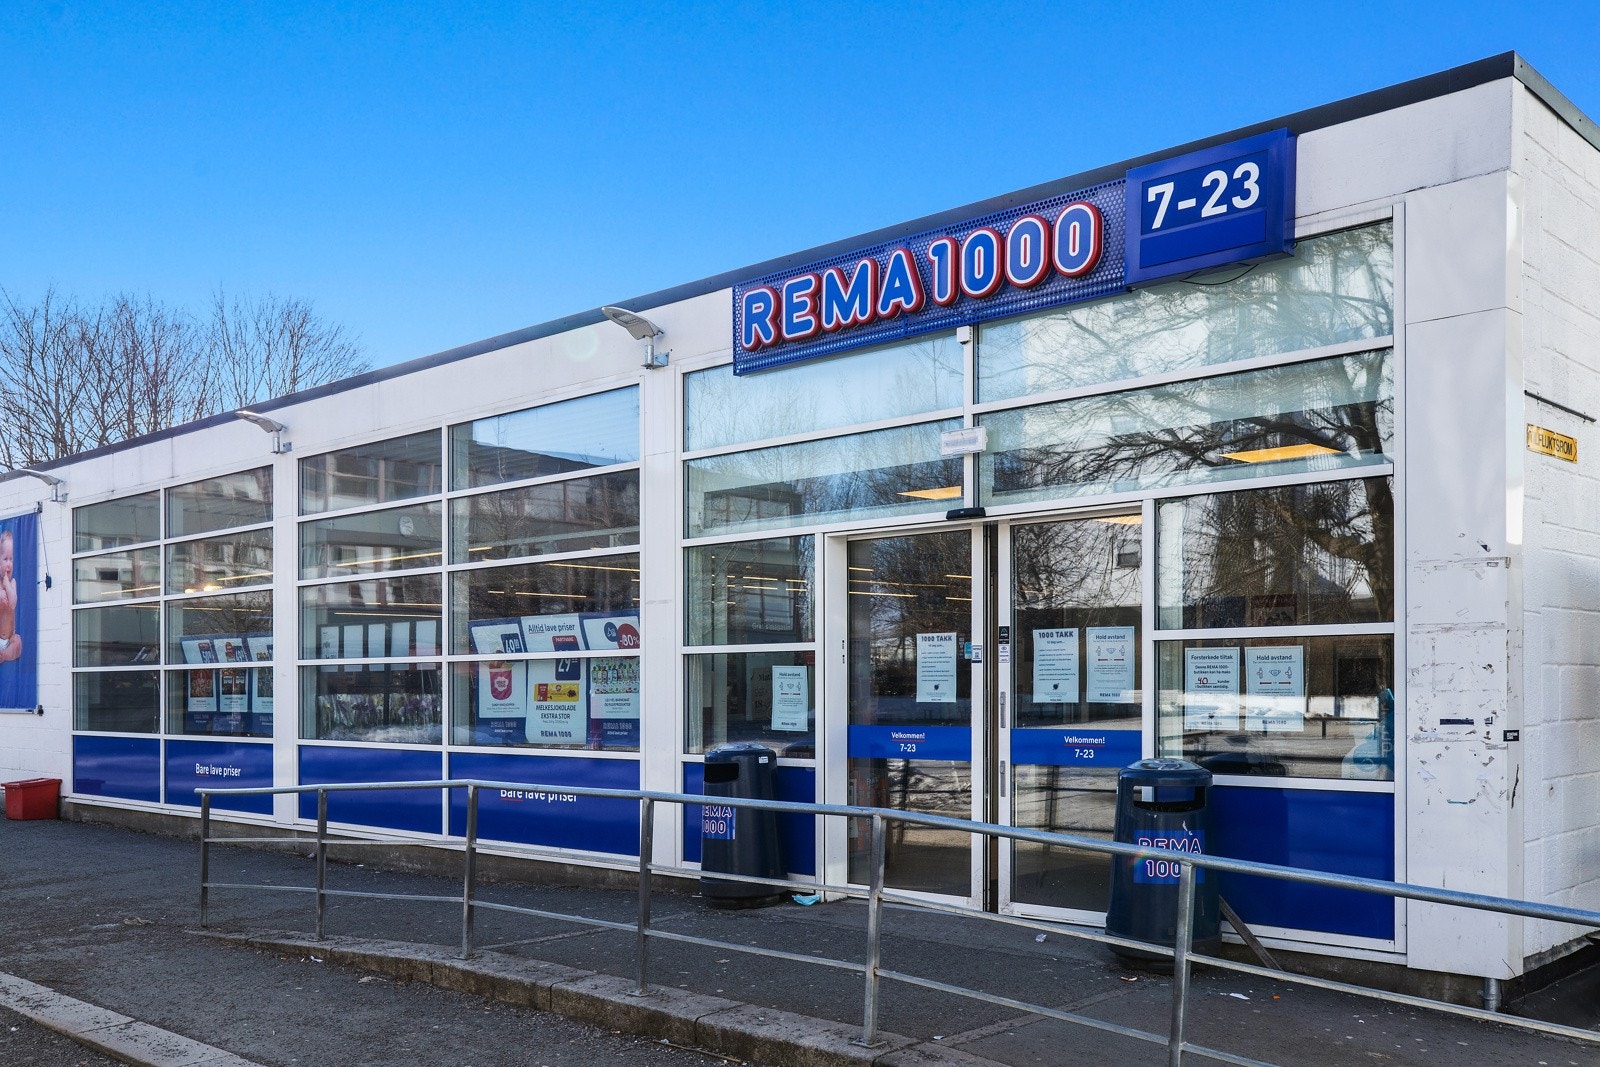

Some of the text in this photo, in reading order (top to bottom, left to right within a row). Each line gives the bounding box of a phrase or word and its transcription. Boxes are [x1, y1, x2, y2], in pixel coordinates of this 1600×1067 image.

[1147, 161, 1261, 230] 7-23
[741, 200, 1104, 351] REMA 1000
[528, 623, 575, 633] Alltid lave priser
[1038, 631, 1054, 639] 1000
[540, 730, 572, 738] REMA 1000
[1063, 735, 1105, 744] Velkommen!
[900, 743, 917, 752] 7-23
[1074, 748, 1095, 759] 7-23
[195, 762, 242, 778] Bare lave priser
[702, 805, 732, 818] EMA
[702, 819, 727, 834] 000
[1145, 859, 1181, 878] 100
